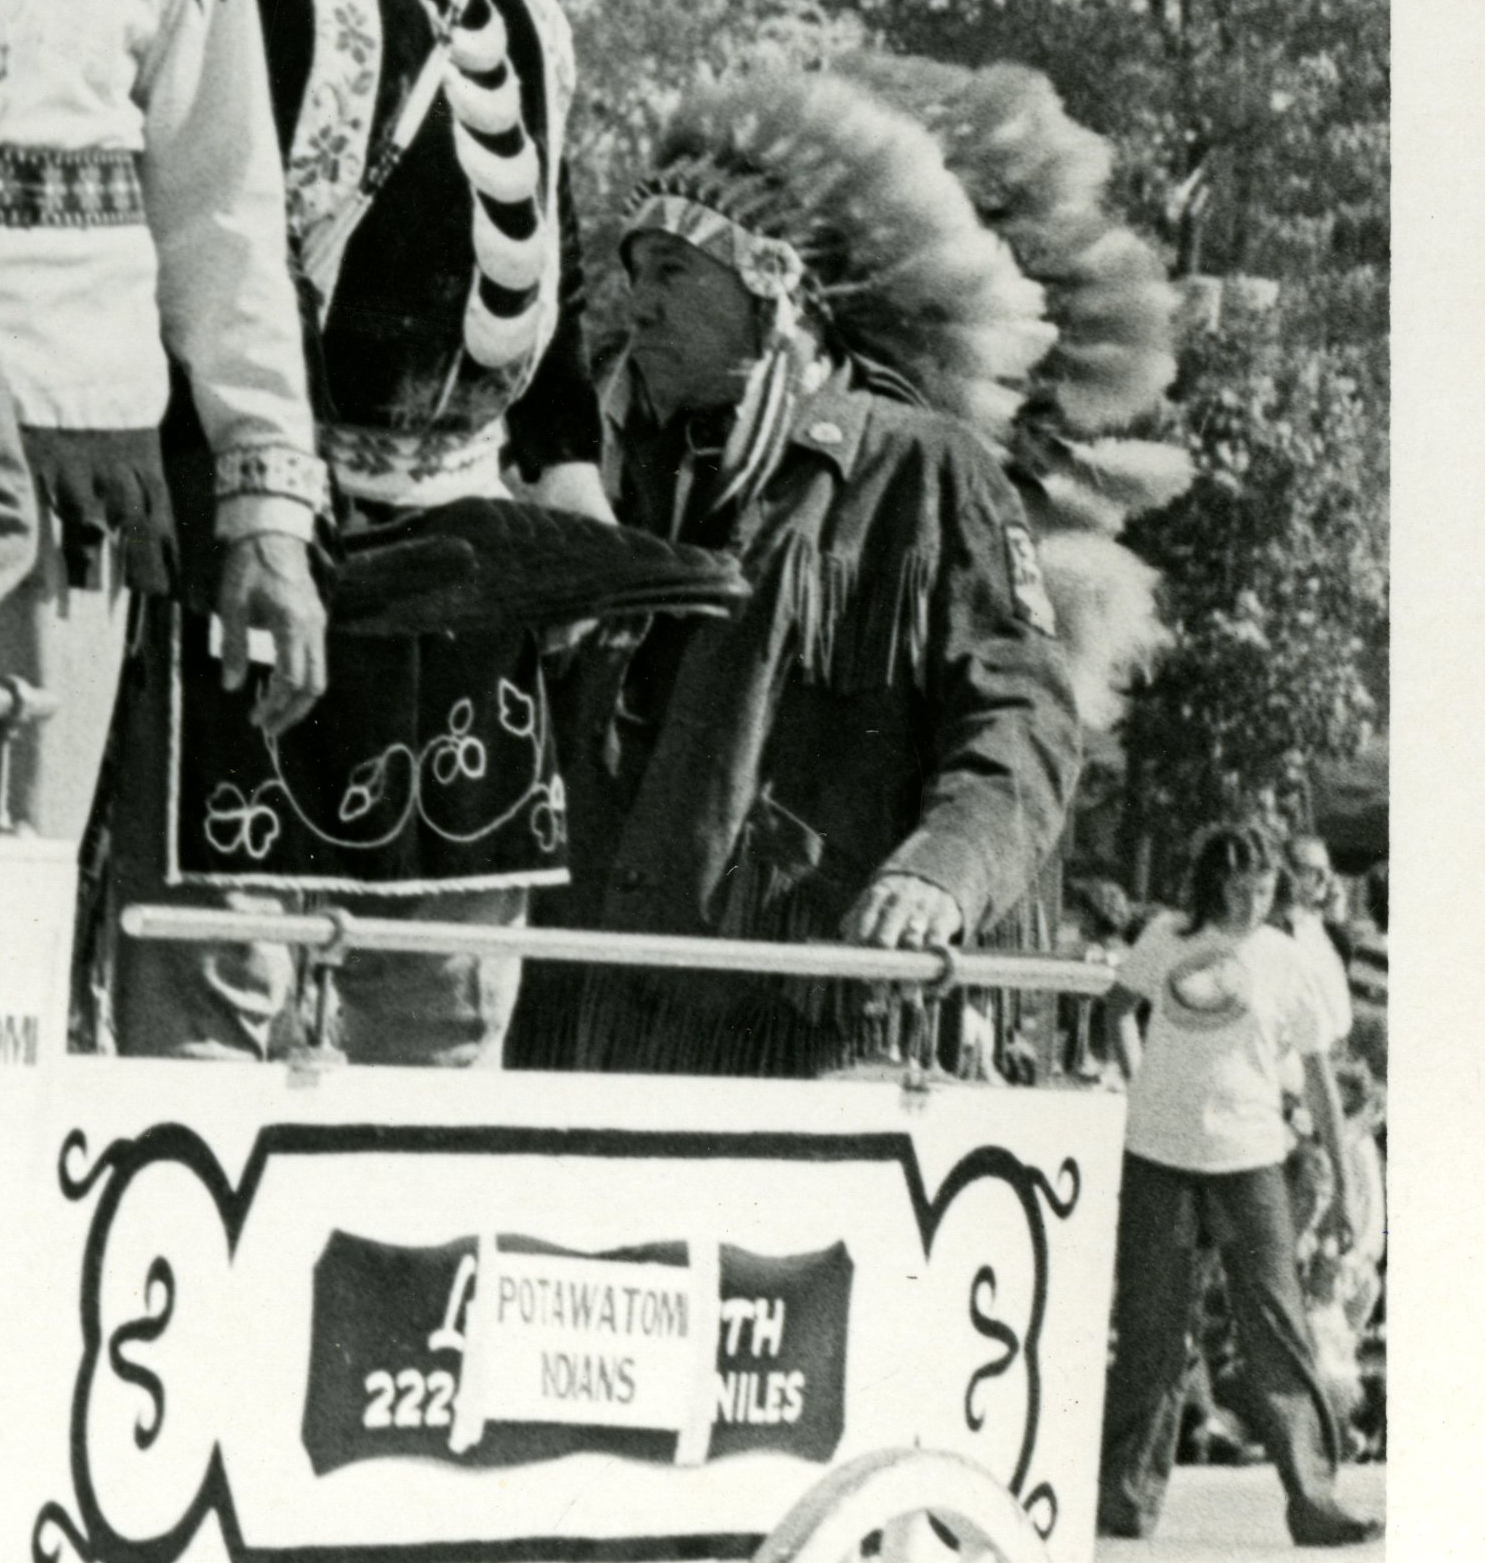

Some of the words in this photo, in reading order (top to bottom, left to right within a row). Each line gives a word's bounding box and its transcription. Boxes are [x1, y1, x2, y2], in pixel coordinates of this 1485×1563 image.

[497, 1275, 690, 1338] POTAWATOMI
[721, 1297, 785, 1358] TH
[362, 1369, 456, 1429] 222
